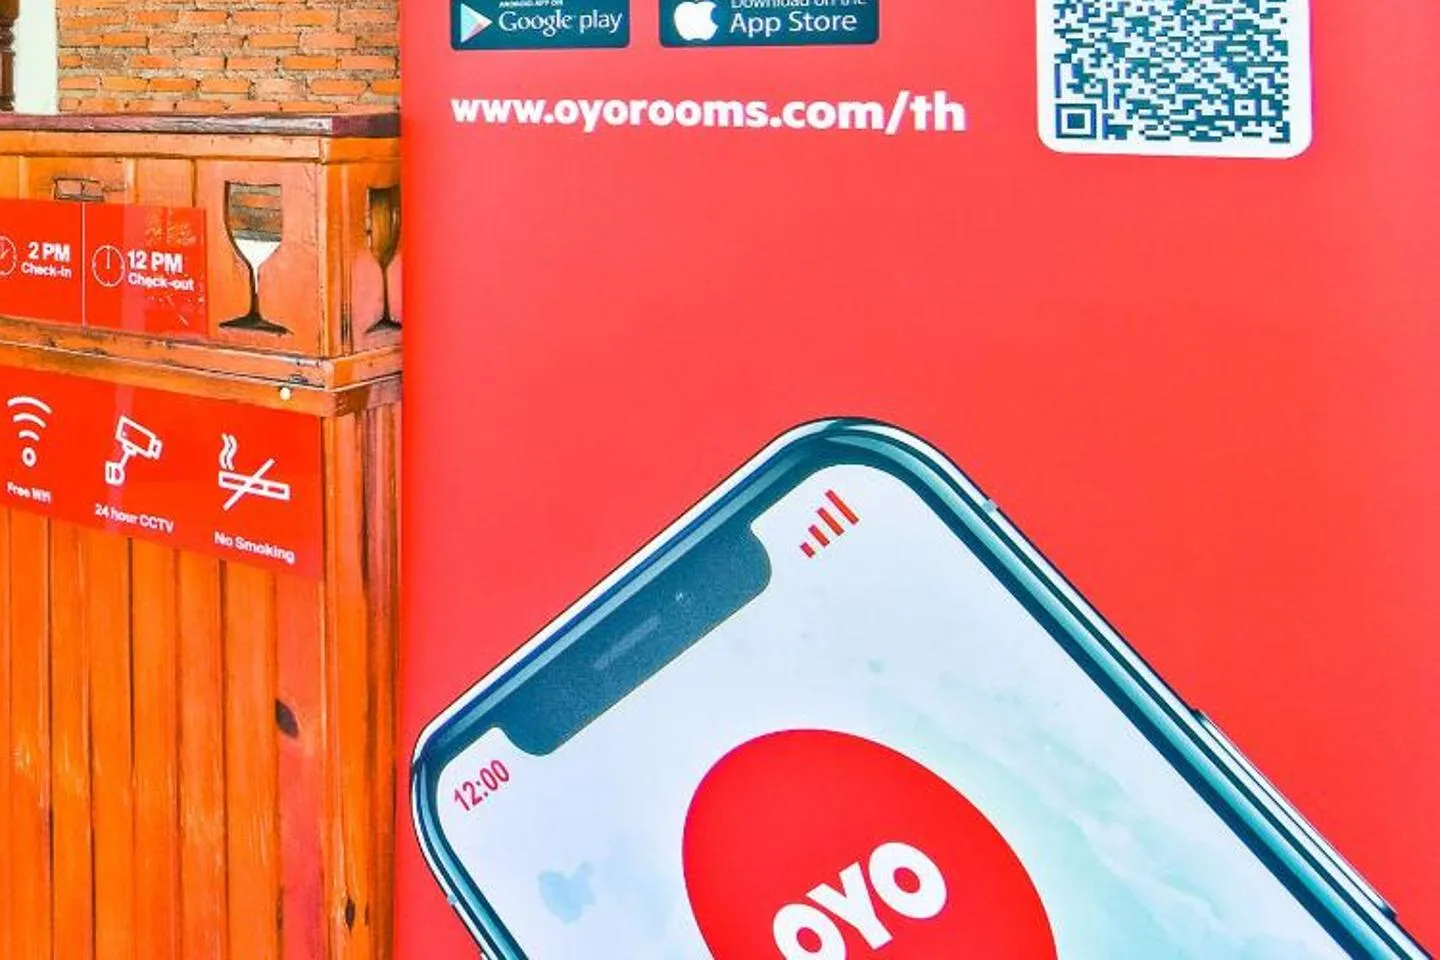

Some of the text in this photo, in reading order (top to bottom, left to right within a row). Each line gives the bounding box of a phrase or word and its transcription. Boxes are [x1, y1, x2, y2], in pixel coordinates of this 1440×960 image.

[498, 9, 623, 37] Google play
[729, 10, 858, 38] App Store
[450, 89, 966, 136] www.oyorooms.com/th
[27, 241, 72, 263] 2 PM
[127, 249, 184, 274] 12 PM
[20, 261, 73, 278] Check-in
[127, 271, 195, 292] Check-out
[95, 503, 174, 534] 24 hour CCTV
[213, 531, 296, 565] No Smoking
[454, 760, 510, 811] 12:00
[772, 841, 947, 960] OYO
